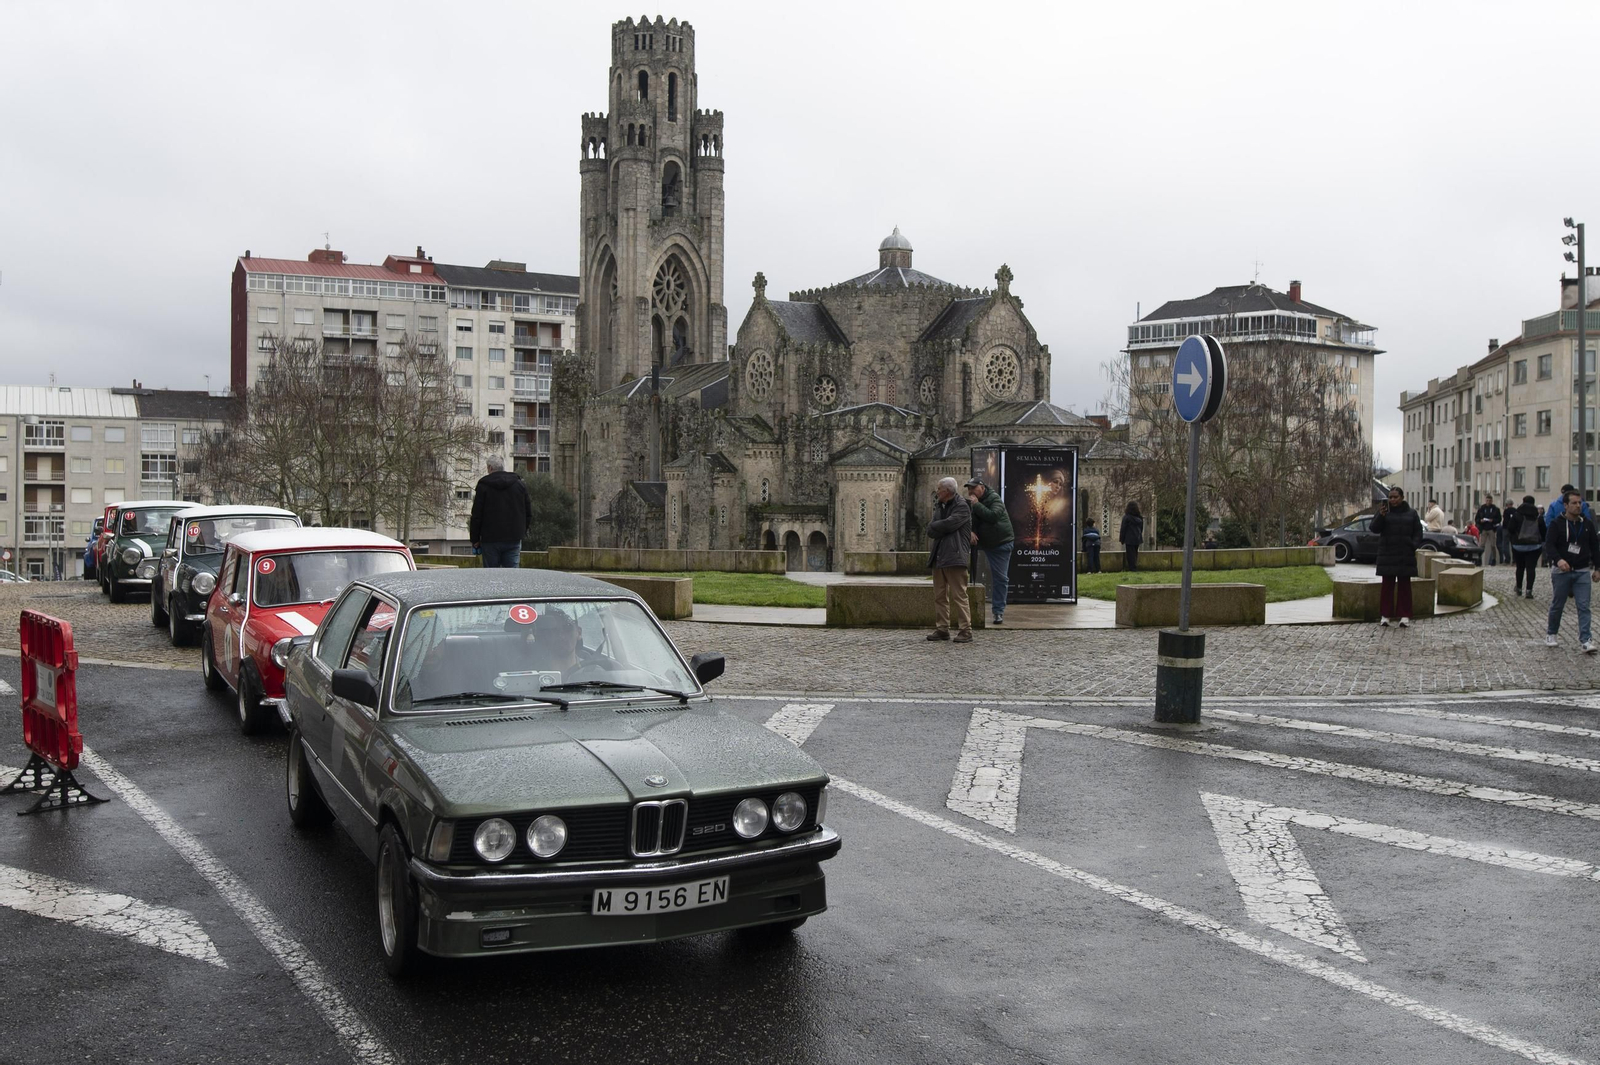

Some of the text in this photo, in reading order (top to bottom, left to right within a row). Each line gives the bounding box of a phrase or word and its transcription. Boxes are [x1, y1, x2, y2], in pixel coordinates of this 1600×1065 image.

[189, 527, 199, 535] 10
[1023, 548, 1060, 556] CARBALLIÑO
[263, 561, 271, 570] 9
[518, 608, 529, 620] 8
[692, 823, 726, 836] 320
[597, 879, 727, 912] M 9156 EN
